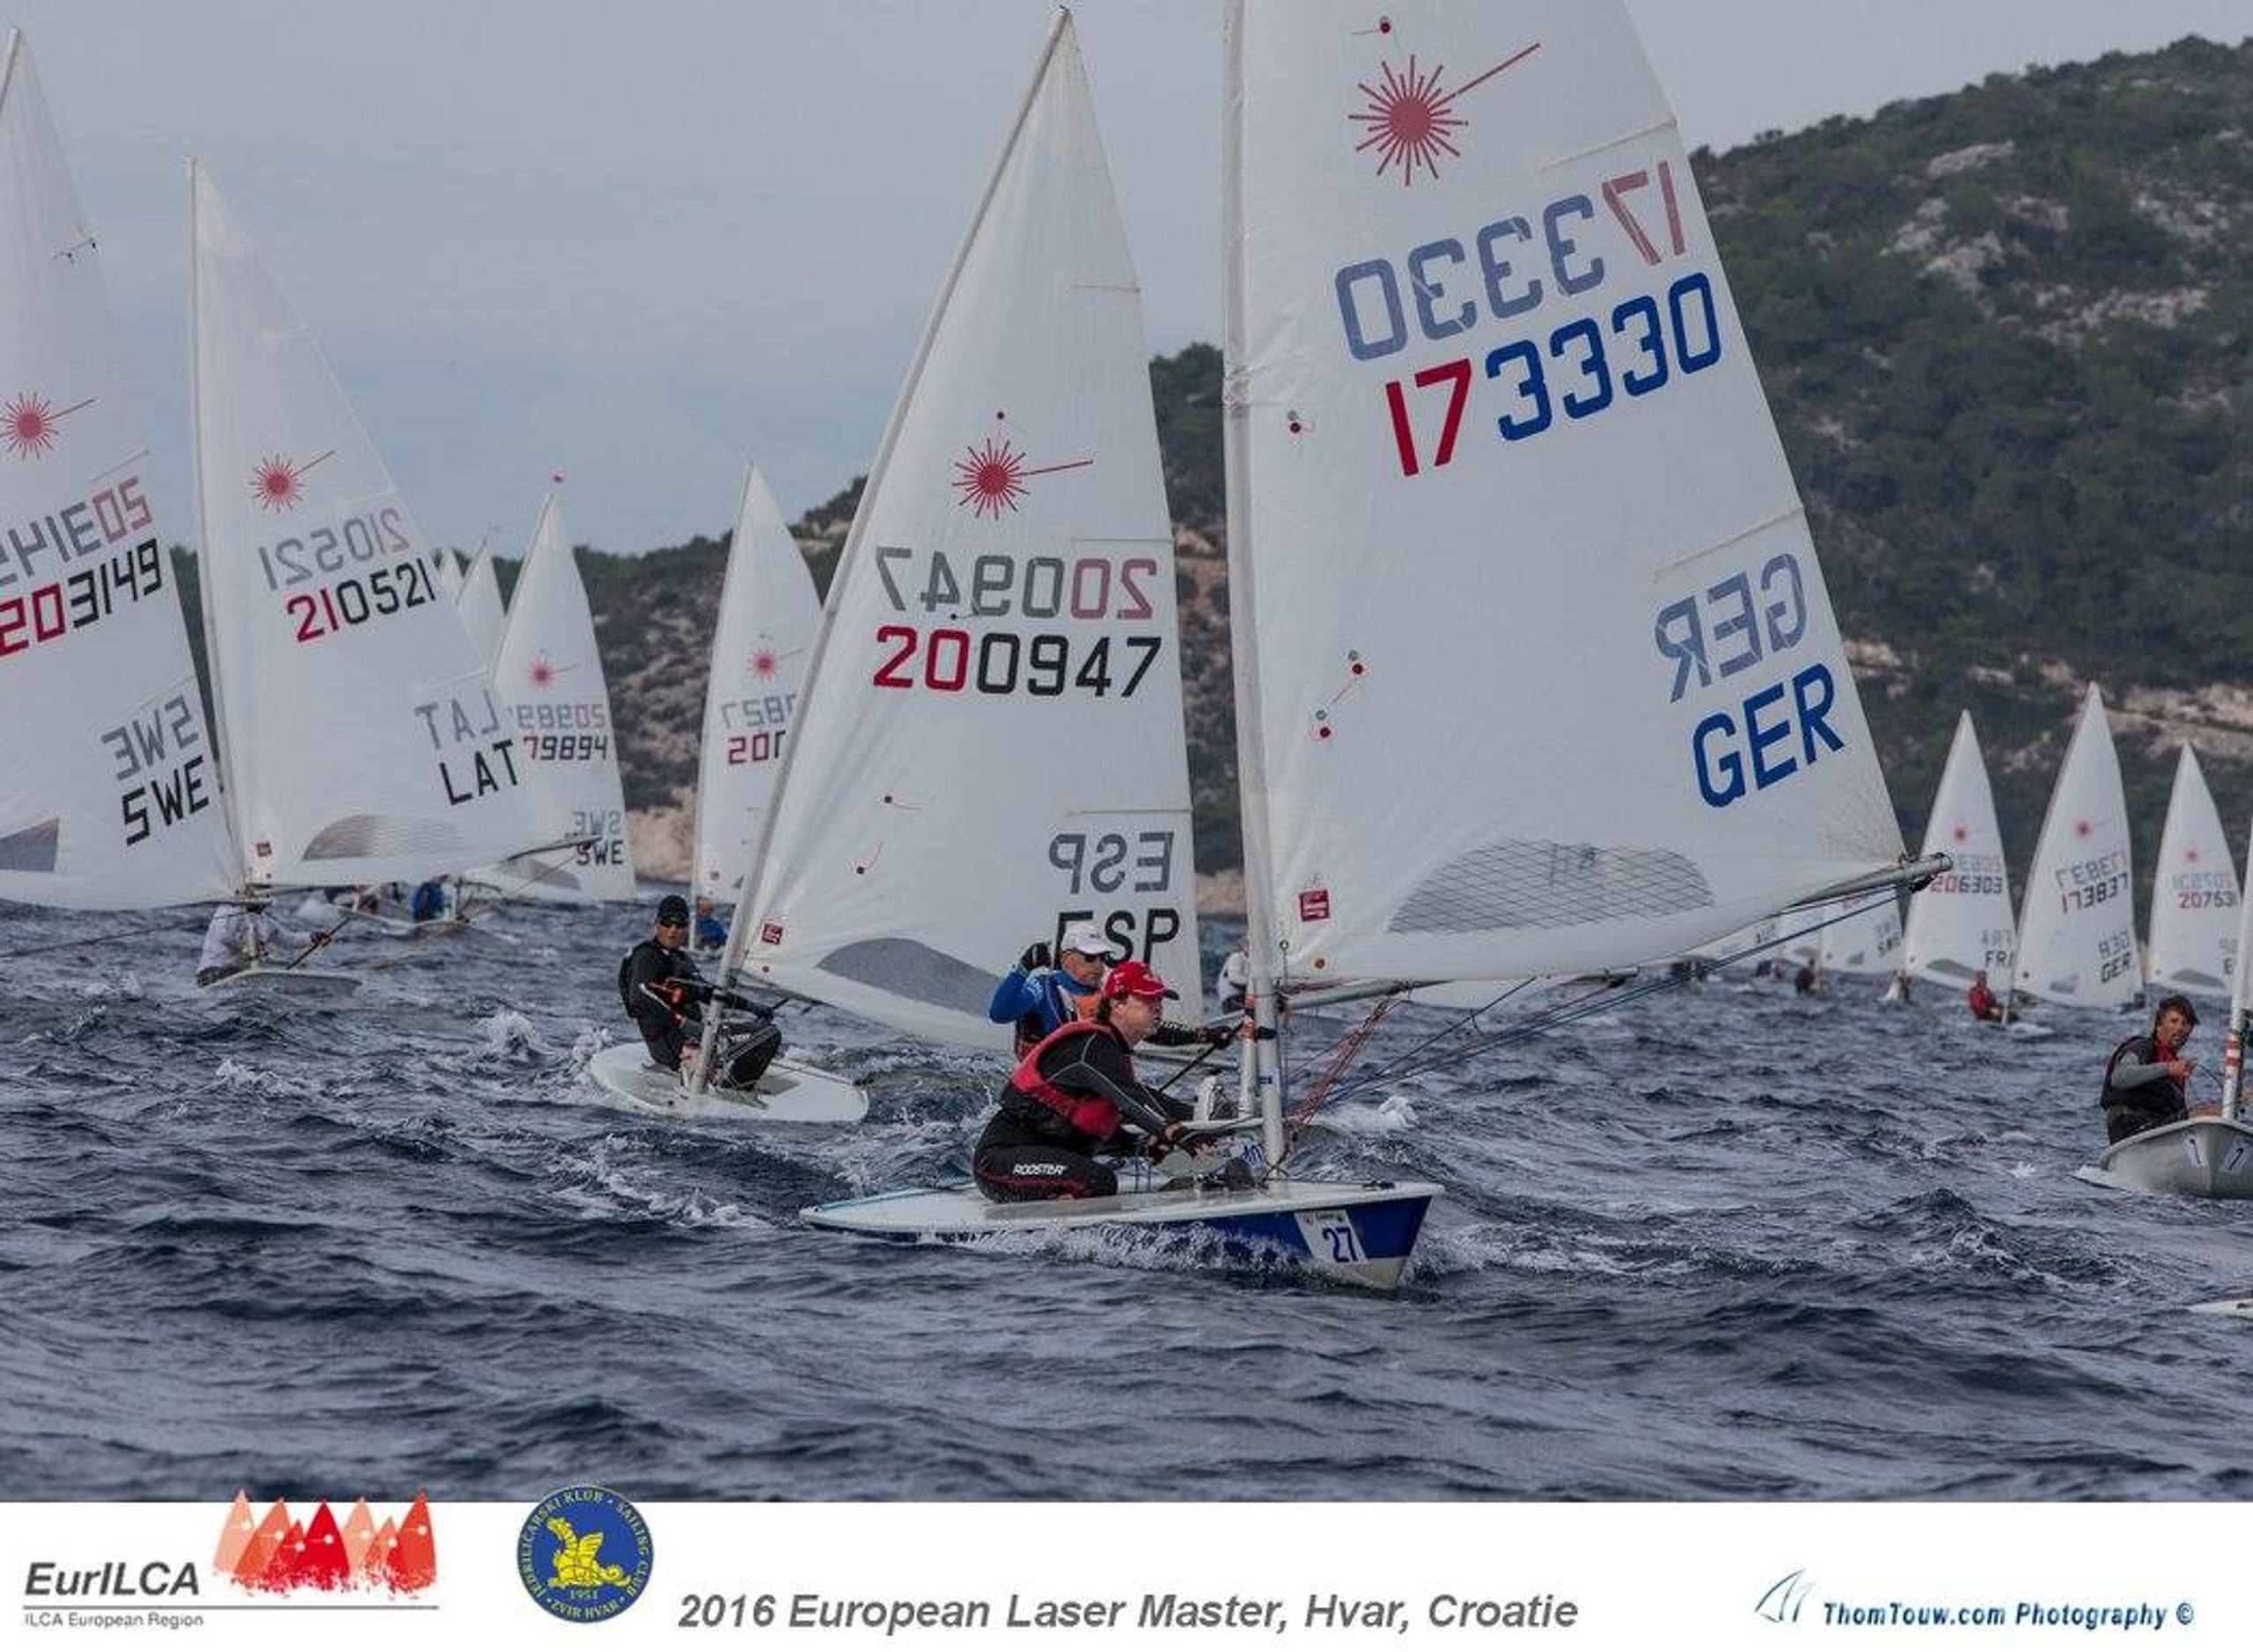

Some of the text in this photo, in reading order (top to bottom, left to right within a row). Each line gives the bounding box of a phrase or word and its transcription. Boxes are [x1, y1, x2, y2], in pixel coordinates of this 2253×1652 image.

[1385, 272, 1721, 476] 173330
[0, 538, 162, 657] 203149
[286, 557, 436, 642] 210521
[873, 625, 1162, 698] 200947
[439, 738, 518, 806] LAT
[1692, 663, 1845, 808] GER
[121, 753, 209, 847] SWE
[576, 841, 624, 866] SWE
[2061, 871, 2128, 914] 173837
[1322, 1227, 1358, 1263] 27
